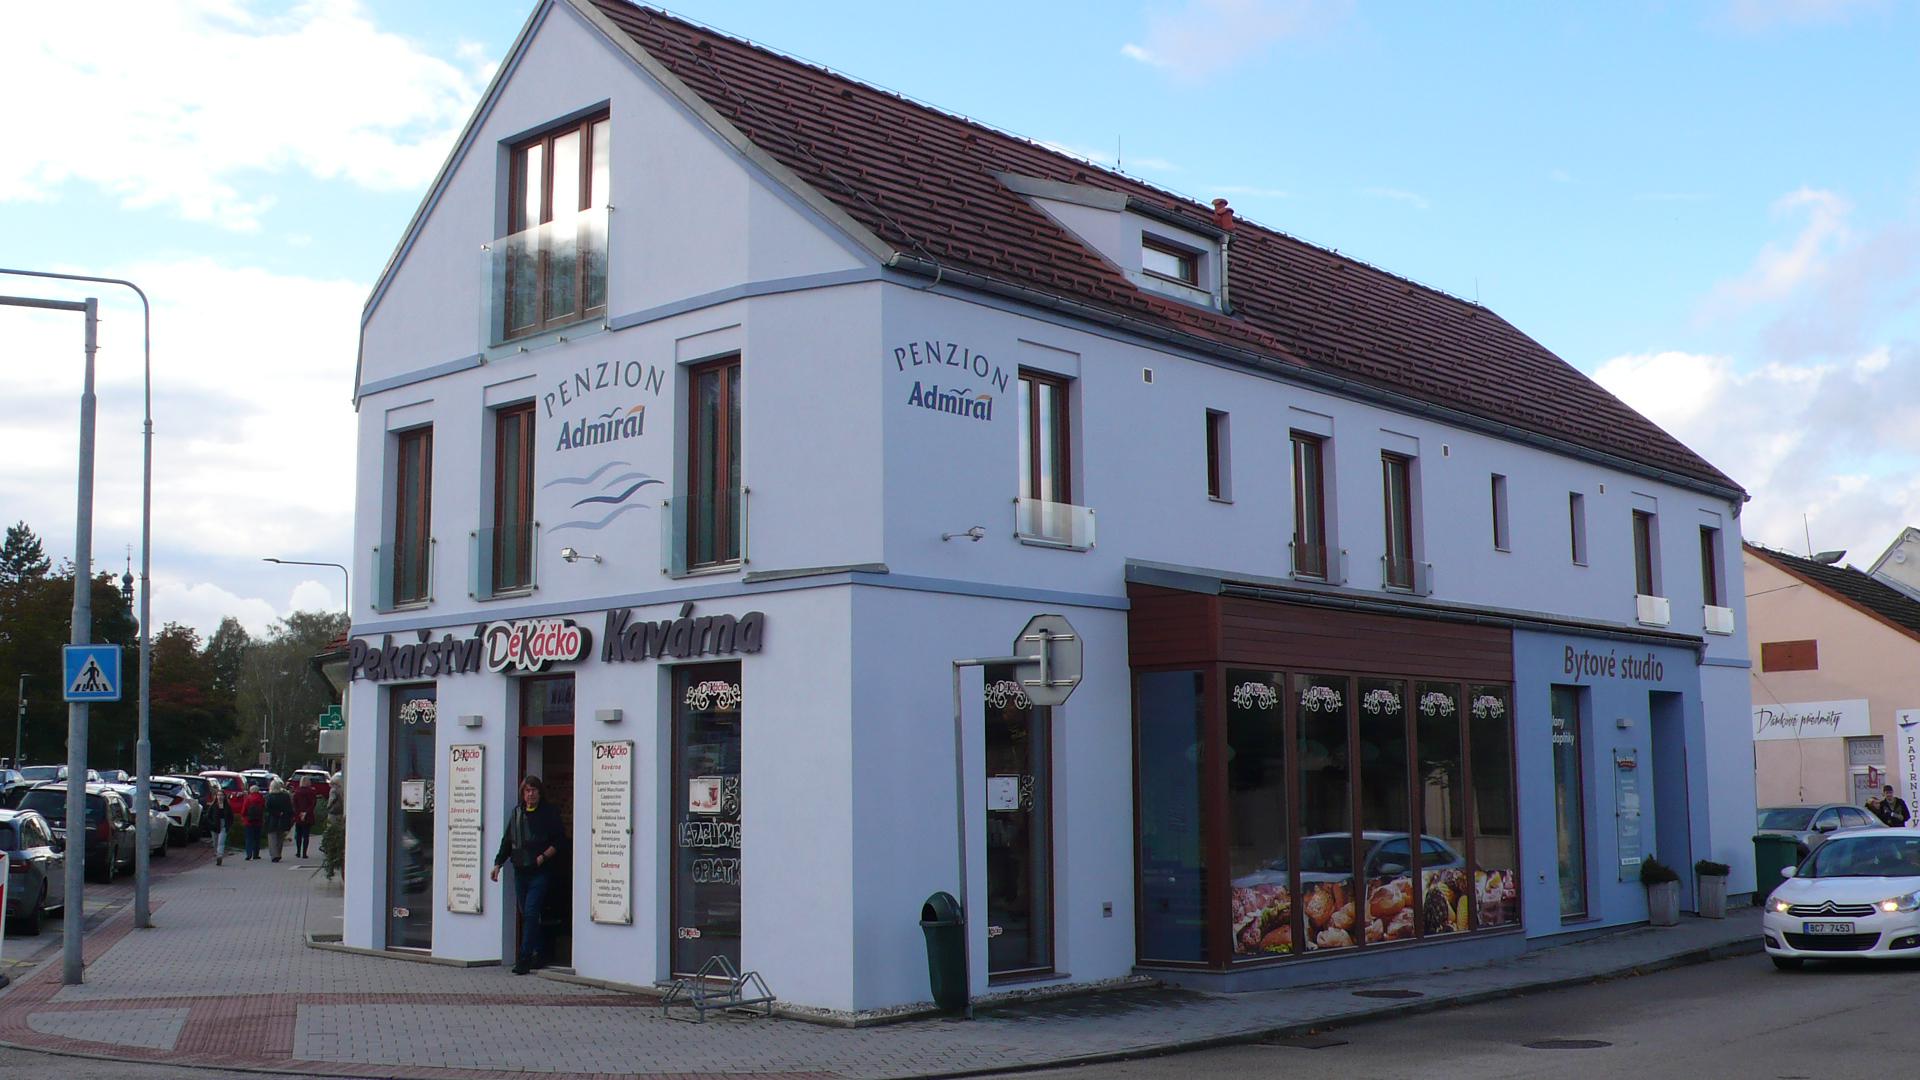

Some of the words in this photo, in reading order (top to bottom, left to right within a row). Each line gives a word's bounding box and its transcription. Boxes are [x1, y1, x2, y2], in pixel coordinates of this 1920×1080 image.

[544, 360, 665, 419] PENZION
[894, 340, 1009, 394] PENZION
[907, 381, 993, 422] Admiral
[556, 404, 646, 452] Admiral
[348, 623, 487, 681] Pekařství
[487, 619, 582, 672] DéKáčko
[602, 602, 765, 663] Kavárna
[1564, 645, 1616, 682] Bytové
[1621, 653, 1664, 682] studio
